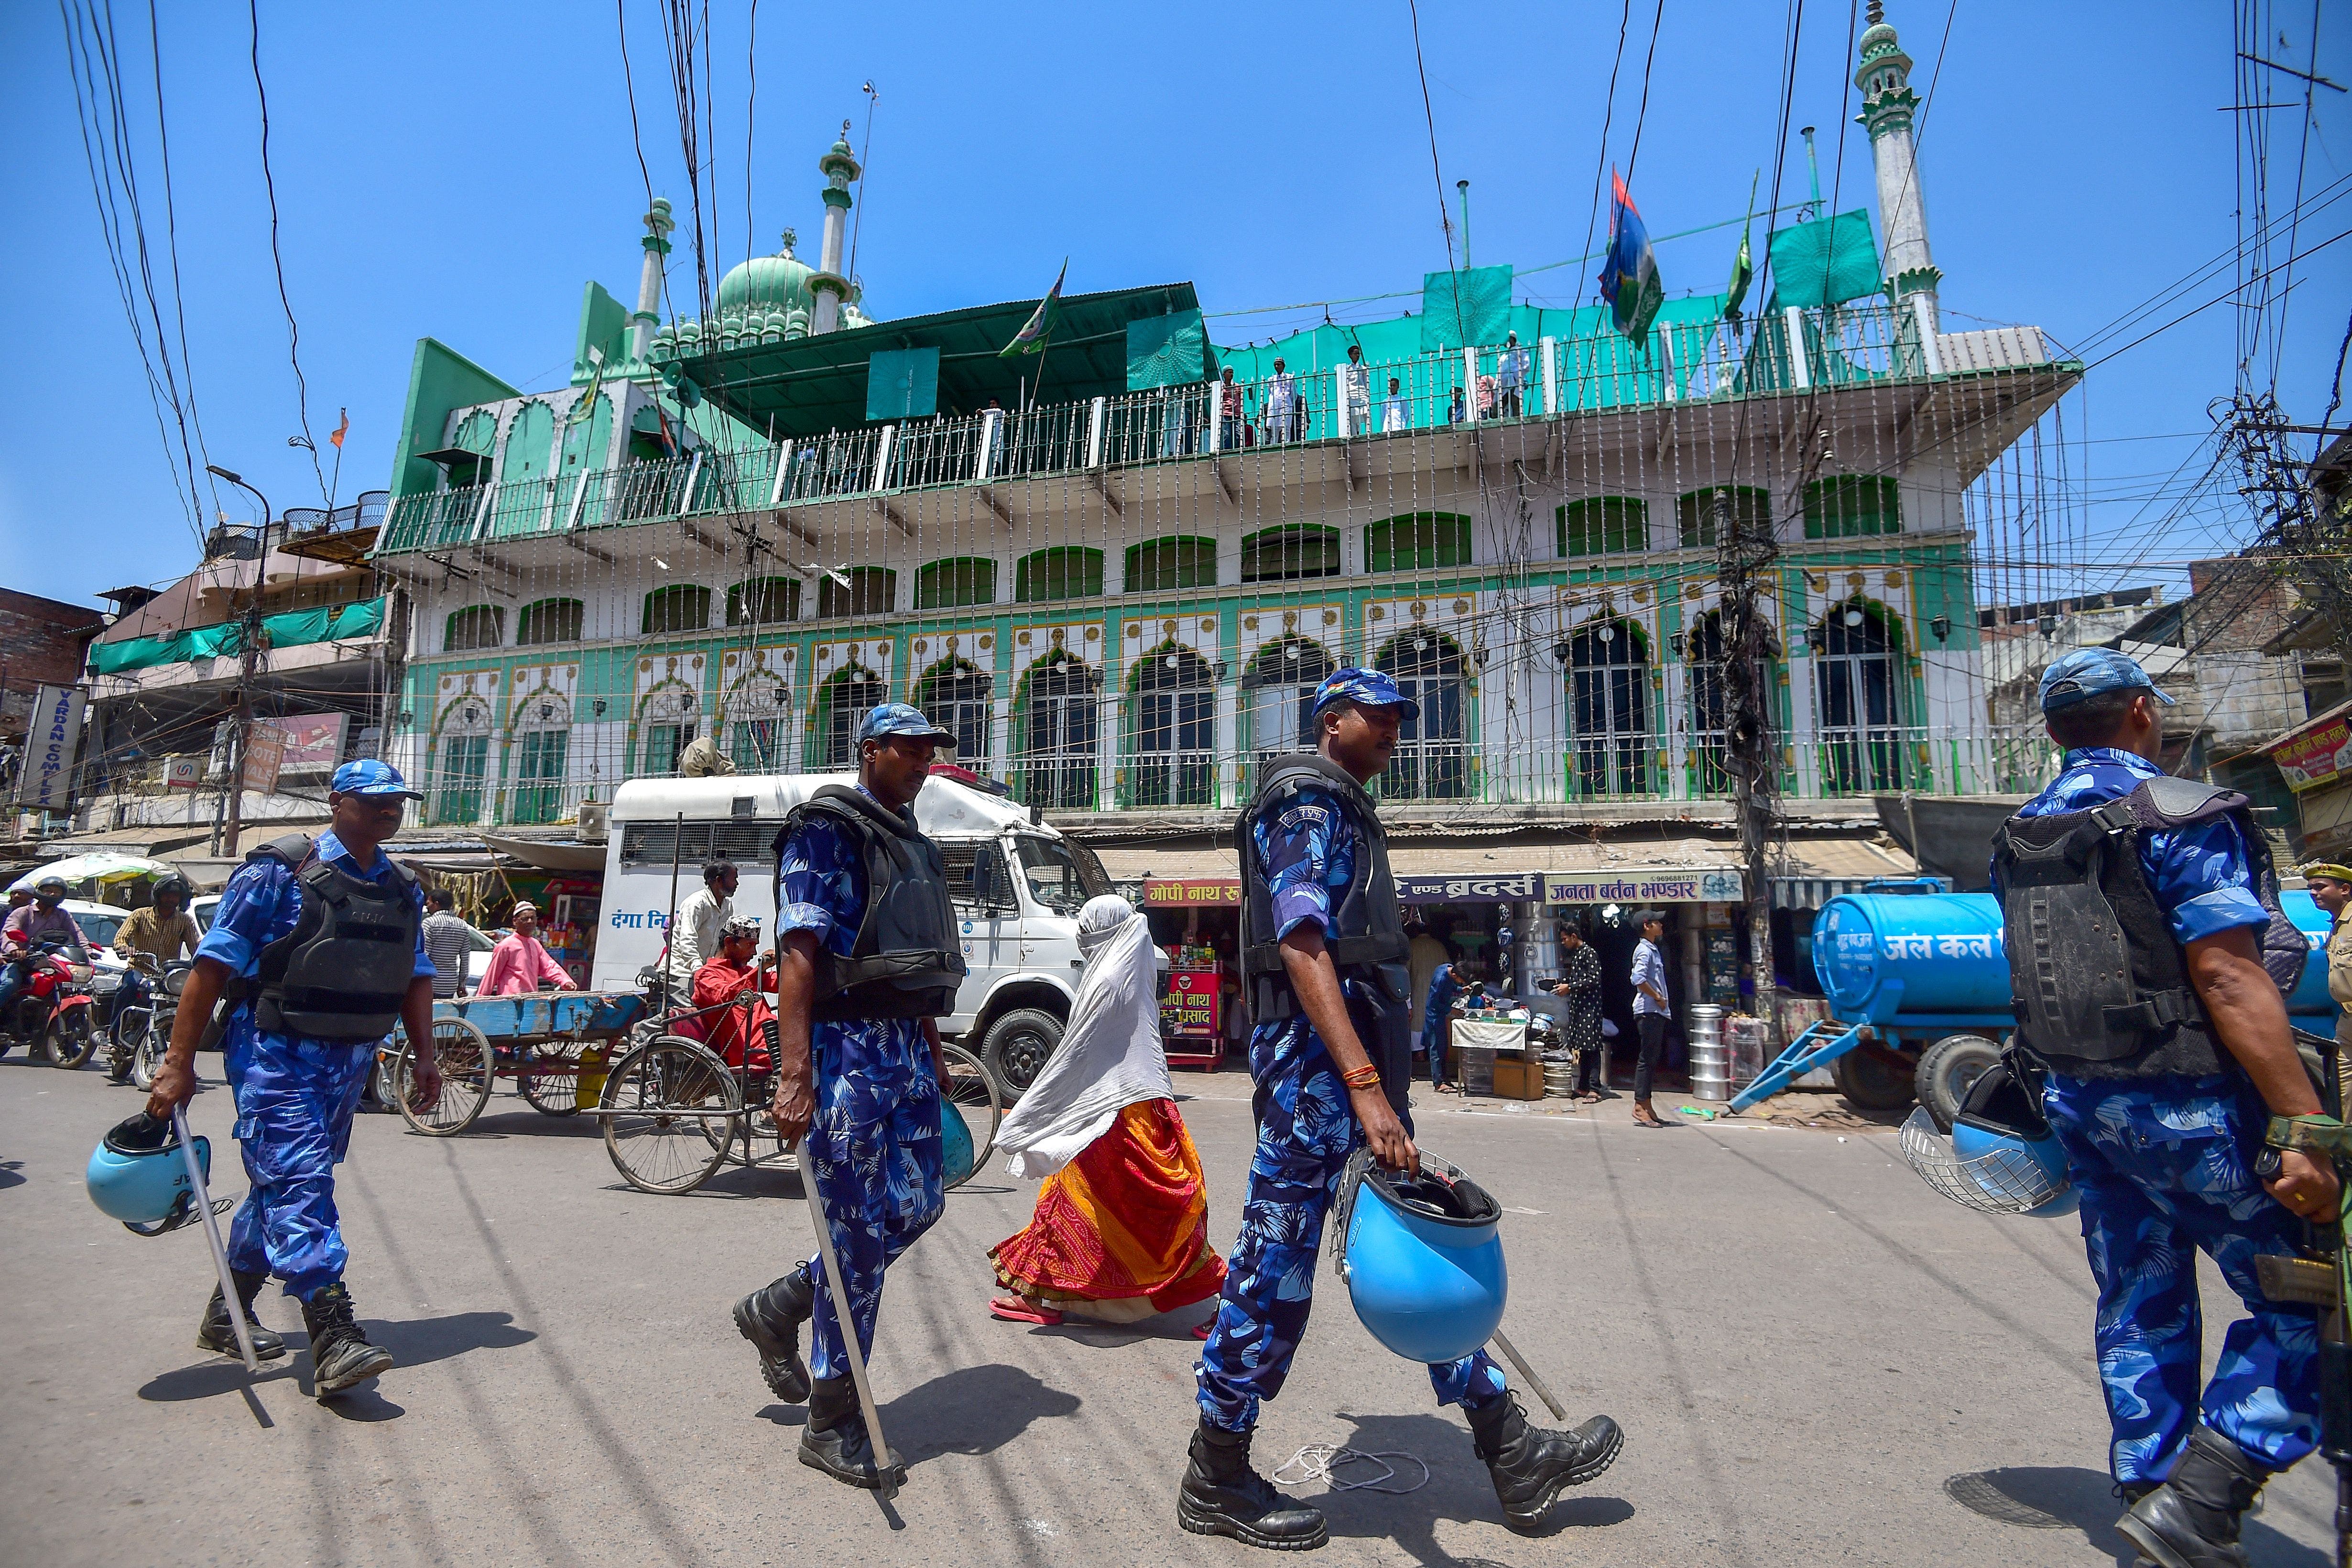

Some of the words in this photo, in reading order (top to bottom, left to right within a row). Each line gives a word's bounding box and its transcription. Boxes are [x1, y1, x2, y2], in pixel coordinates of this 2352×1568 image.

[50, 689, 73, 741] VARDAN
[1150, 883, 1184, 901] गोपी
[1187, 886, 1221, 901] नाथ
[1411, 885, 1443, 895] एण्ड
[1445, 875, 1536, 898] ब्रदर्स
[1549, 883, 1597, 901] जनता
[1599, 879, 1638, 900] बर्तन
[1640, 882, 1698, 900] भण्डार
[611, 909, 644, 928] दंगा
[1884, 935, 1933, 960] जल
[1936, 934, 1992, 959] कल
[1187, 994, 1210, 1006] नाथ
